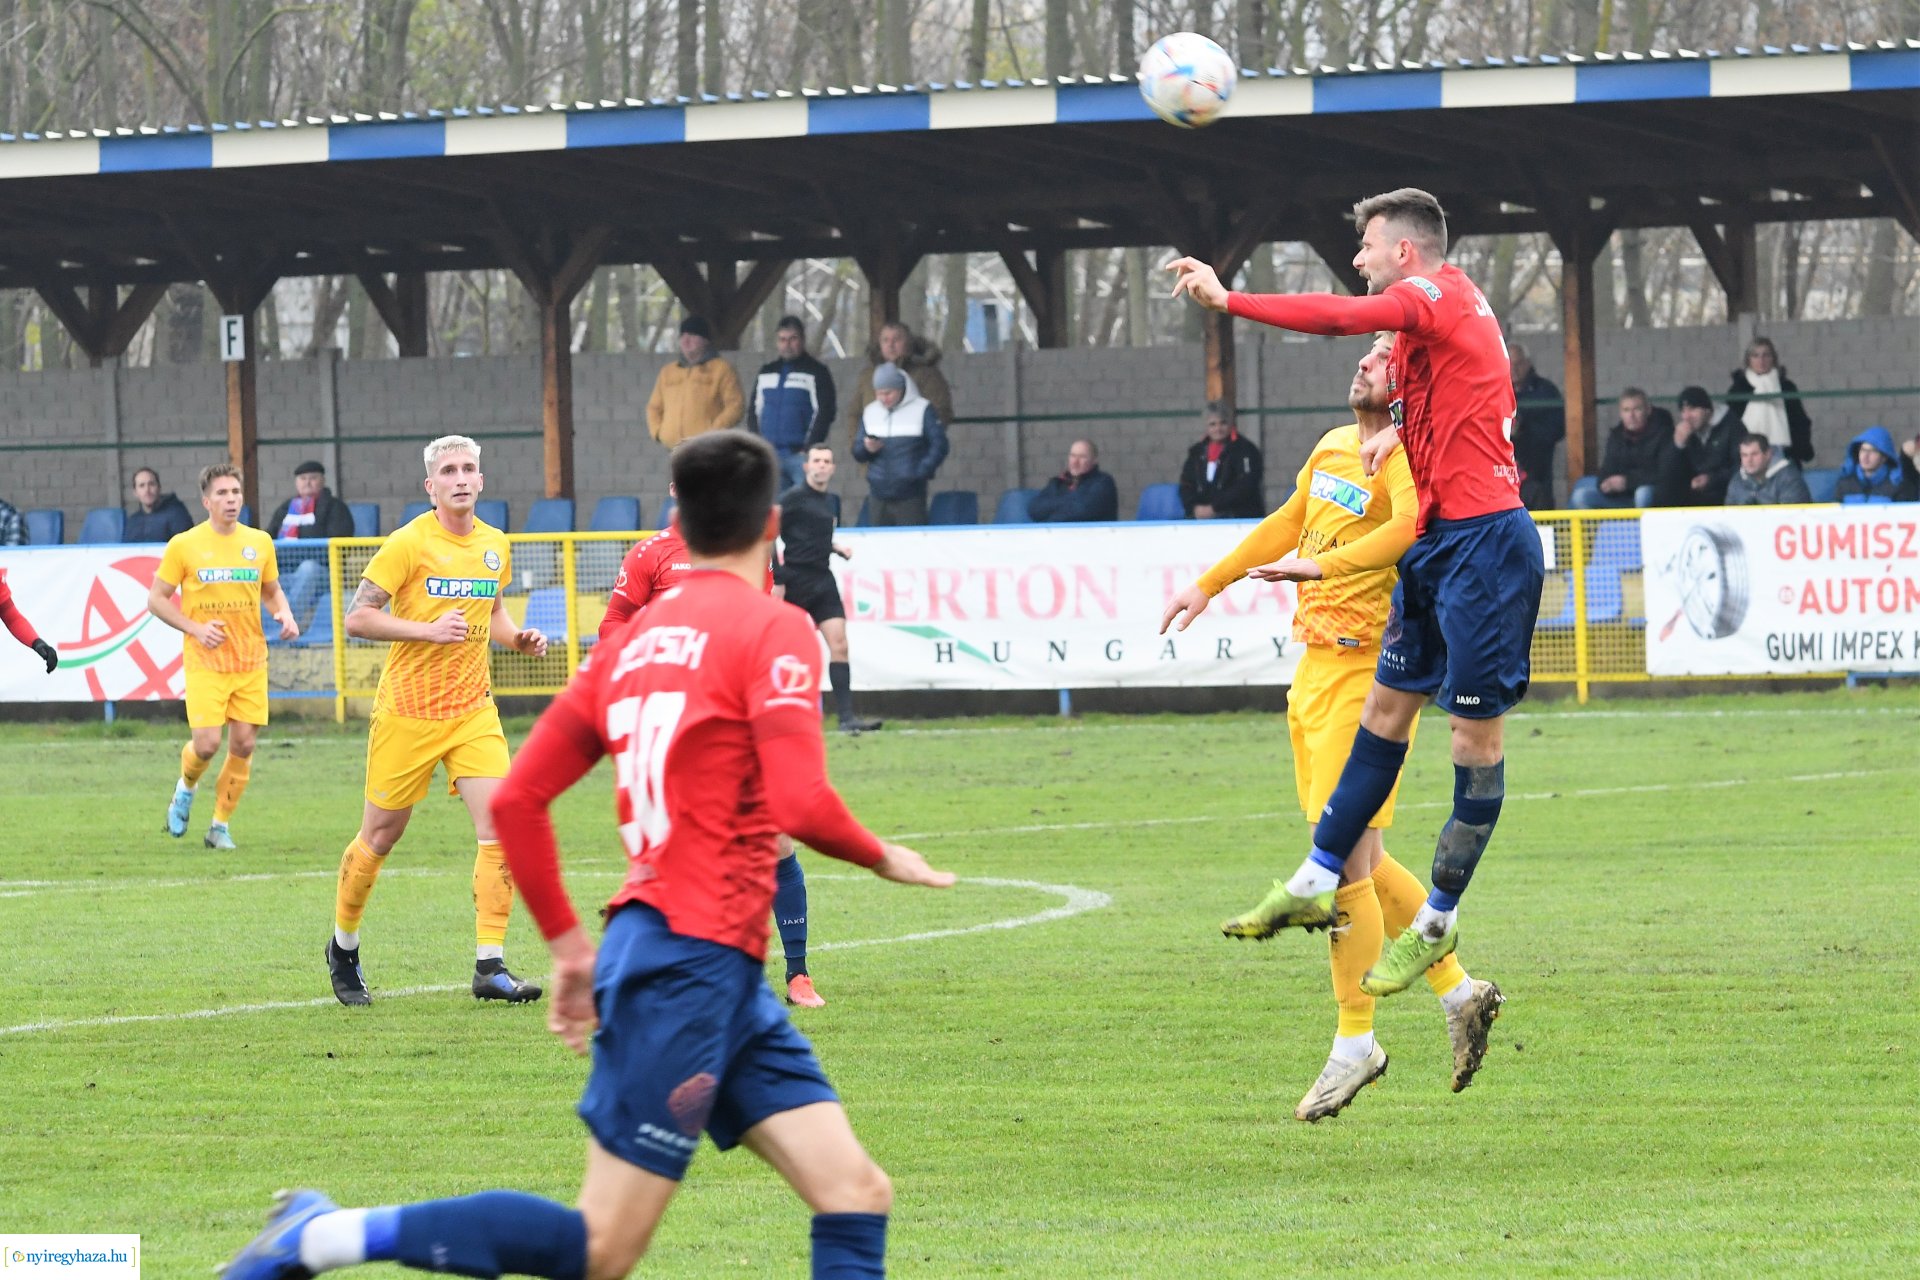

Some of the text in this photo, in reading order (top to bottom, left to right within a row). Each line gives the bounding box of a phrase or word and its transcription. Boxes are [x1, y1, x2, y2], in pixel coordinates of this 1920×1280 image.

[226, 320, 238, 356] F
[671, 562, 692, 571] JAKO
[935, 636, 1288, 664] HUNGARY
[1766, 632, 1823, 662] GUMI
[1833, 630, 1904, 661] IMPEX
[1455, 694, 1481, 705] JAKO
[606, 691, 688, 857] 30
[782, 917, 805, 926] JAKO
